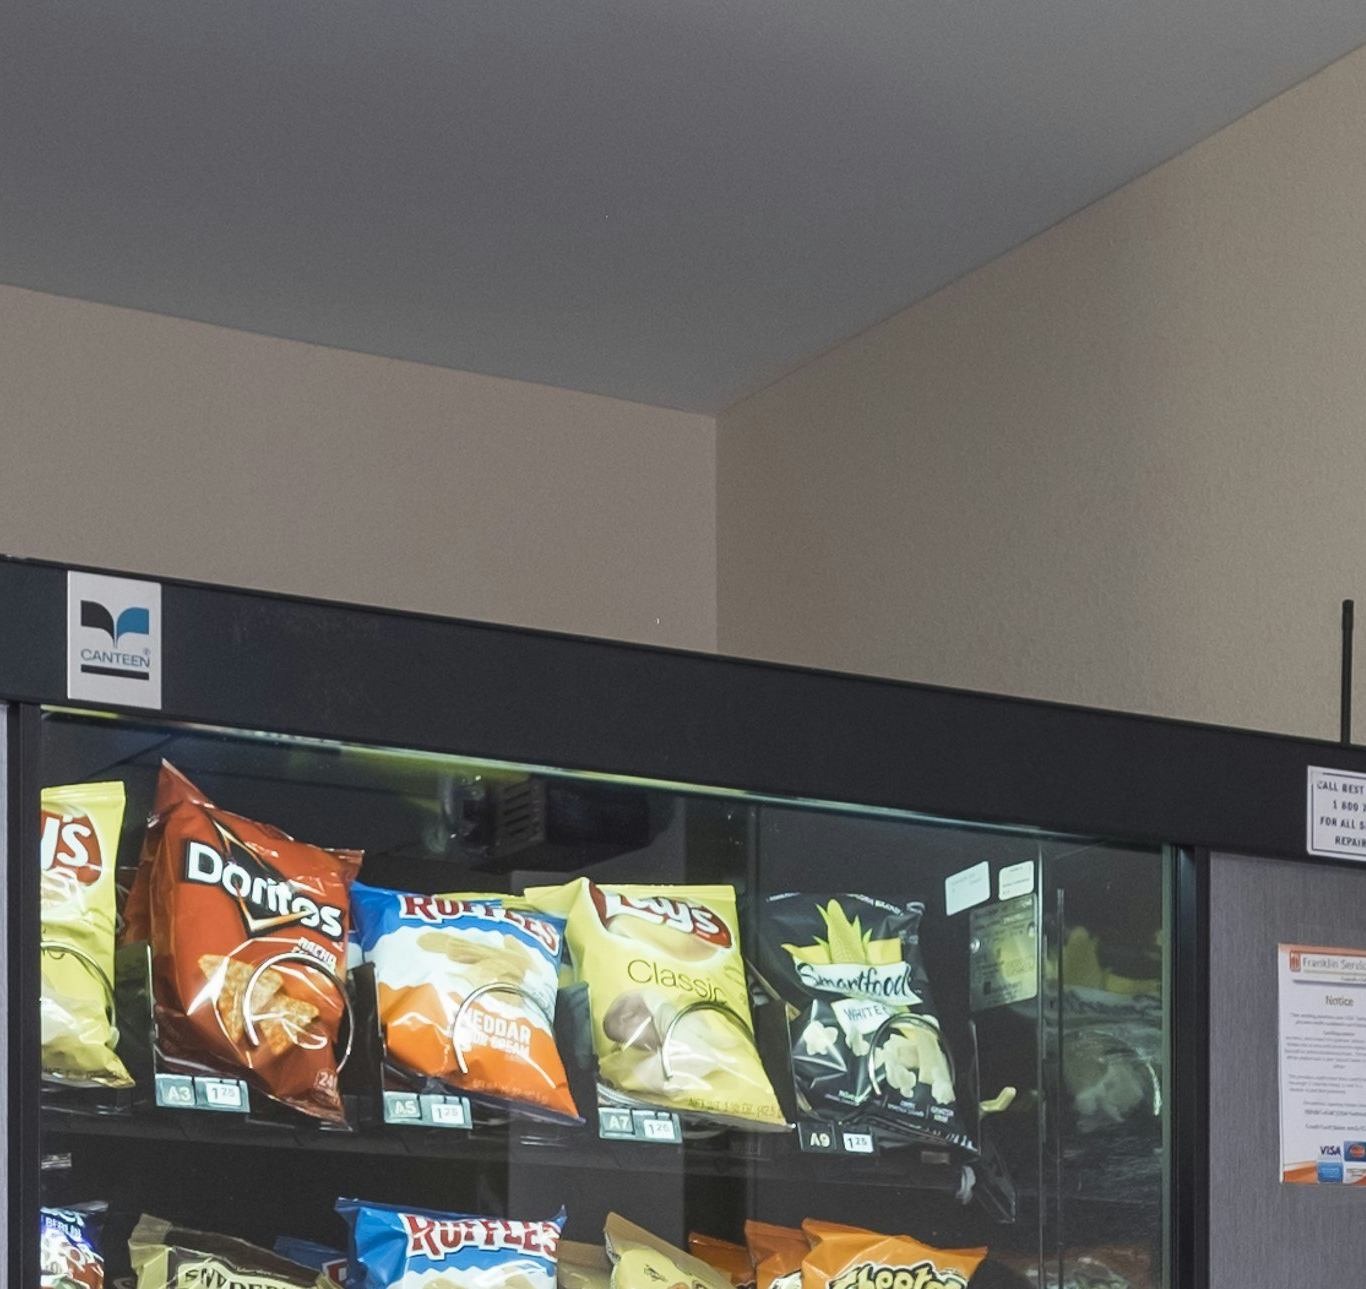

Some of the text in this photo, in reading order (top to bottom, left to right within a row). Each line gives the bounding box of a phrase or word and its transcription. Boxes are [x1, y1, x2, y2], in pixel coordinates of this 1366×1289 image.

[80, 648, 151, 668] CANTEEN
[1317, 781, 1338, 792] CALL
[1342, 783, 1364, 795] BEST
[1341, 801, 1359, 812] 800
[1320, 816, 1337, 827] FOR
[1340, 819, 1356, 830] ALL
[188, 841, 343, 938] Doritos
[1302, 956, 1339, 969] Franklin
[799, 964, 911, 997] Smartfood
[1325, 995, 1354, 1007] Notice
[167, 1085, 192, 1101] A3
[394, 1102, 417, 1115] A5
[609, 1116, 630, 1130] A7
[810, 1132, 831, 1148] A9
[1320, 1145, 1342, 1157] VISA
[406, 1215, 560, 1262] RUFFLES
